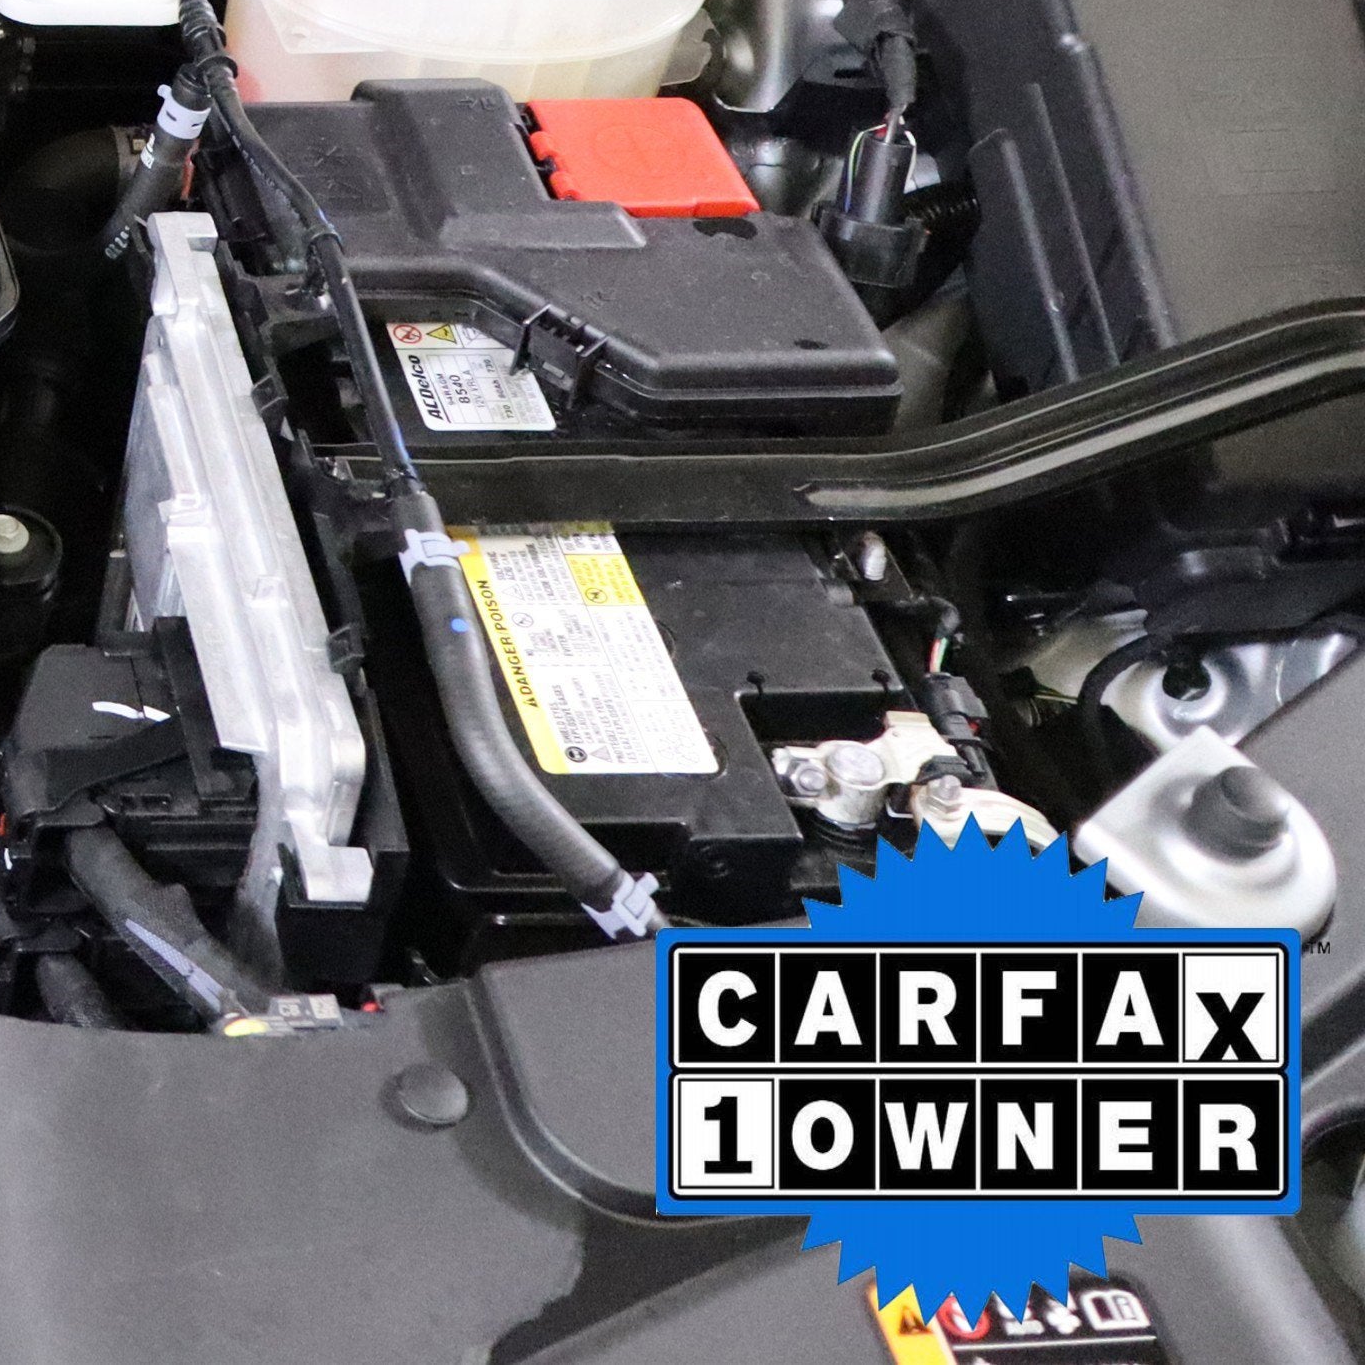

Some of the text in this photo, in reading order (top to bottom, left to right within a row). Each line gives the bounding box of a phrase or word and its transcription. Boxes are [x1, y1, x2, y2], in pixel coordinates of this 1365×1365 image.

[407, 355, 443, 420] ACDelco
[449, 374, 471, 403] 8540
[475, 580, 533, 694] DANGER/POISON
